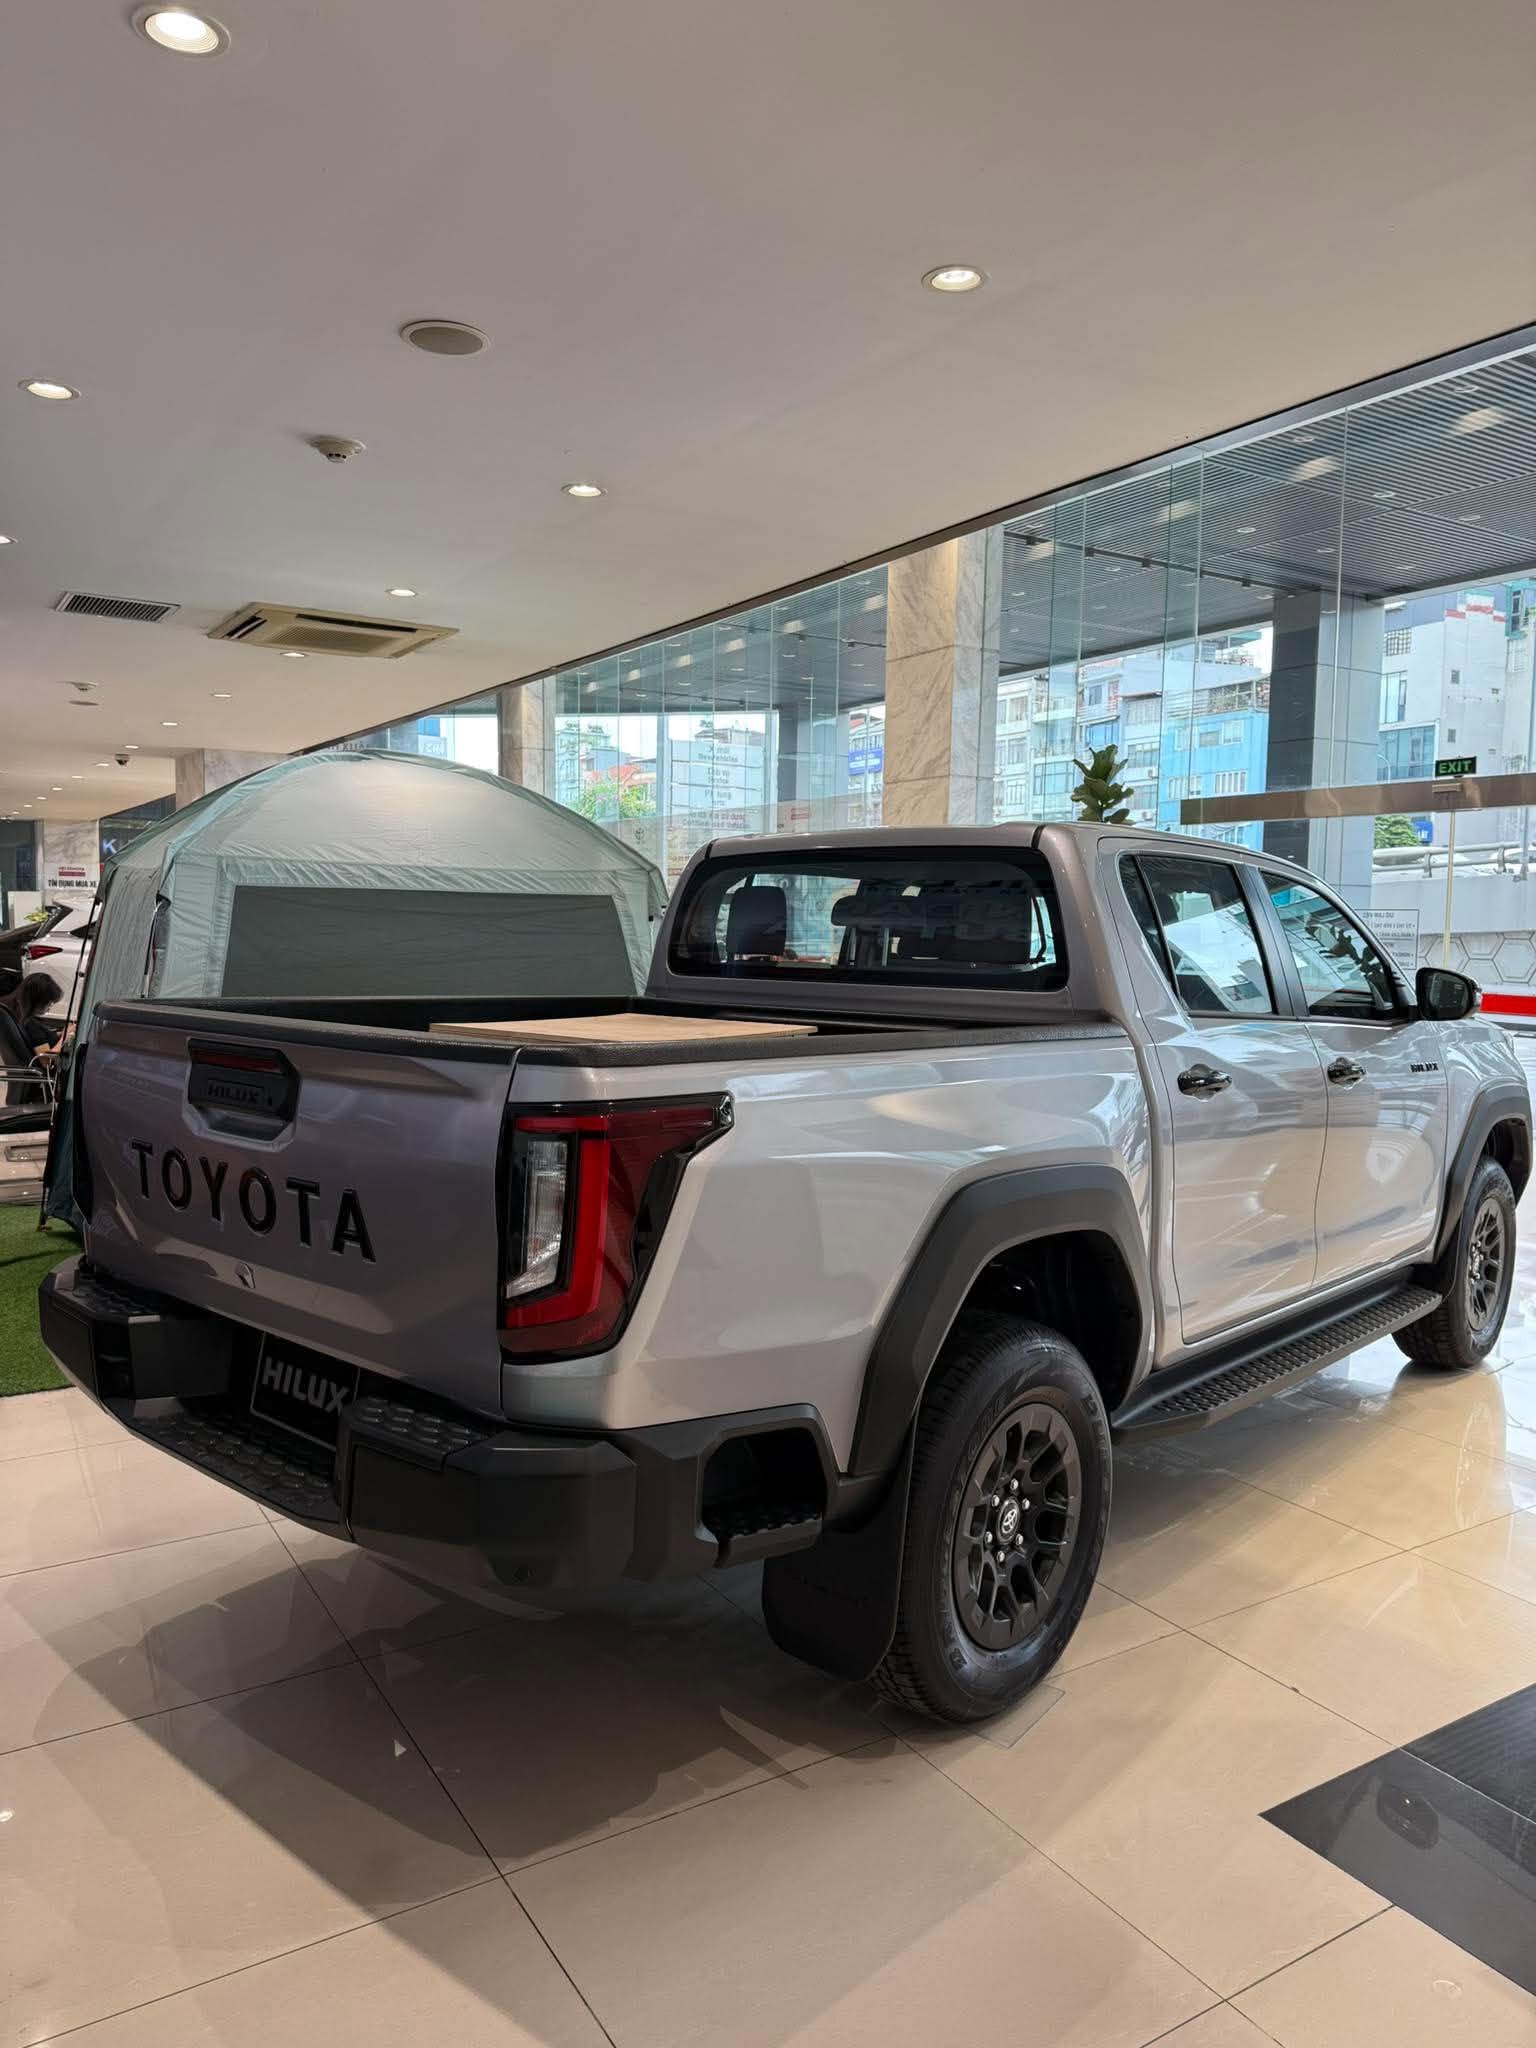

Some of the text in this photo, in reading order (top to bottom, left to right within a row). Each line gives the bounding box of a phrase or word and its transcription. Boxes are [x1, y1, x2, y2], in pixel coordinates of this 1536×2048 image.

[1439, 760, 1473, 774] EXIT
[75, 879, 89, 888] MUA
[89, 880, 98, 888] XE
[1410, 1062, 1439, 1073] HILUX
[130, 1137, 377, 1264] TOYOTA
[262, 1355, 350, 1417] HILUX
